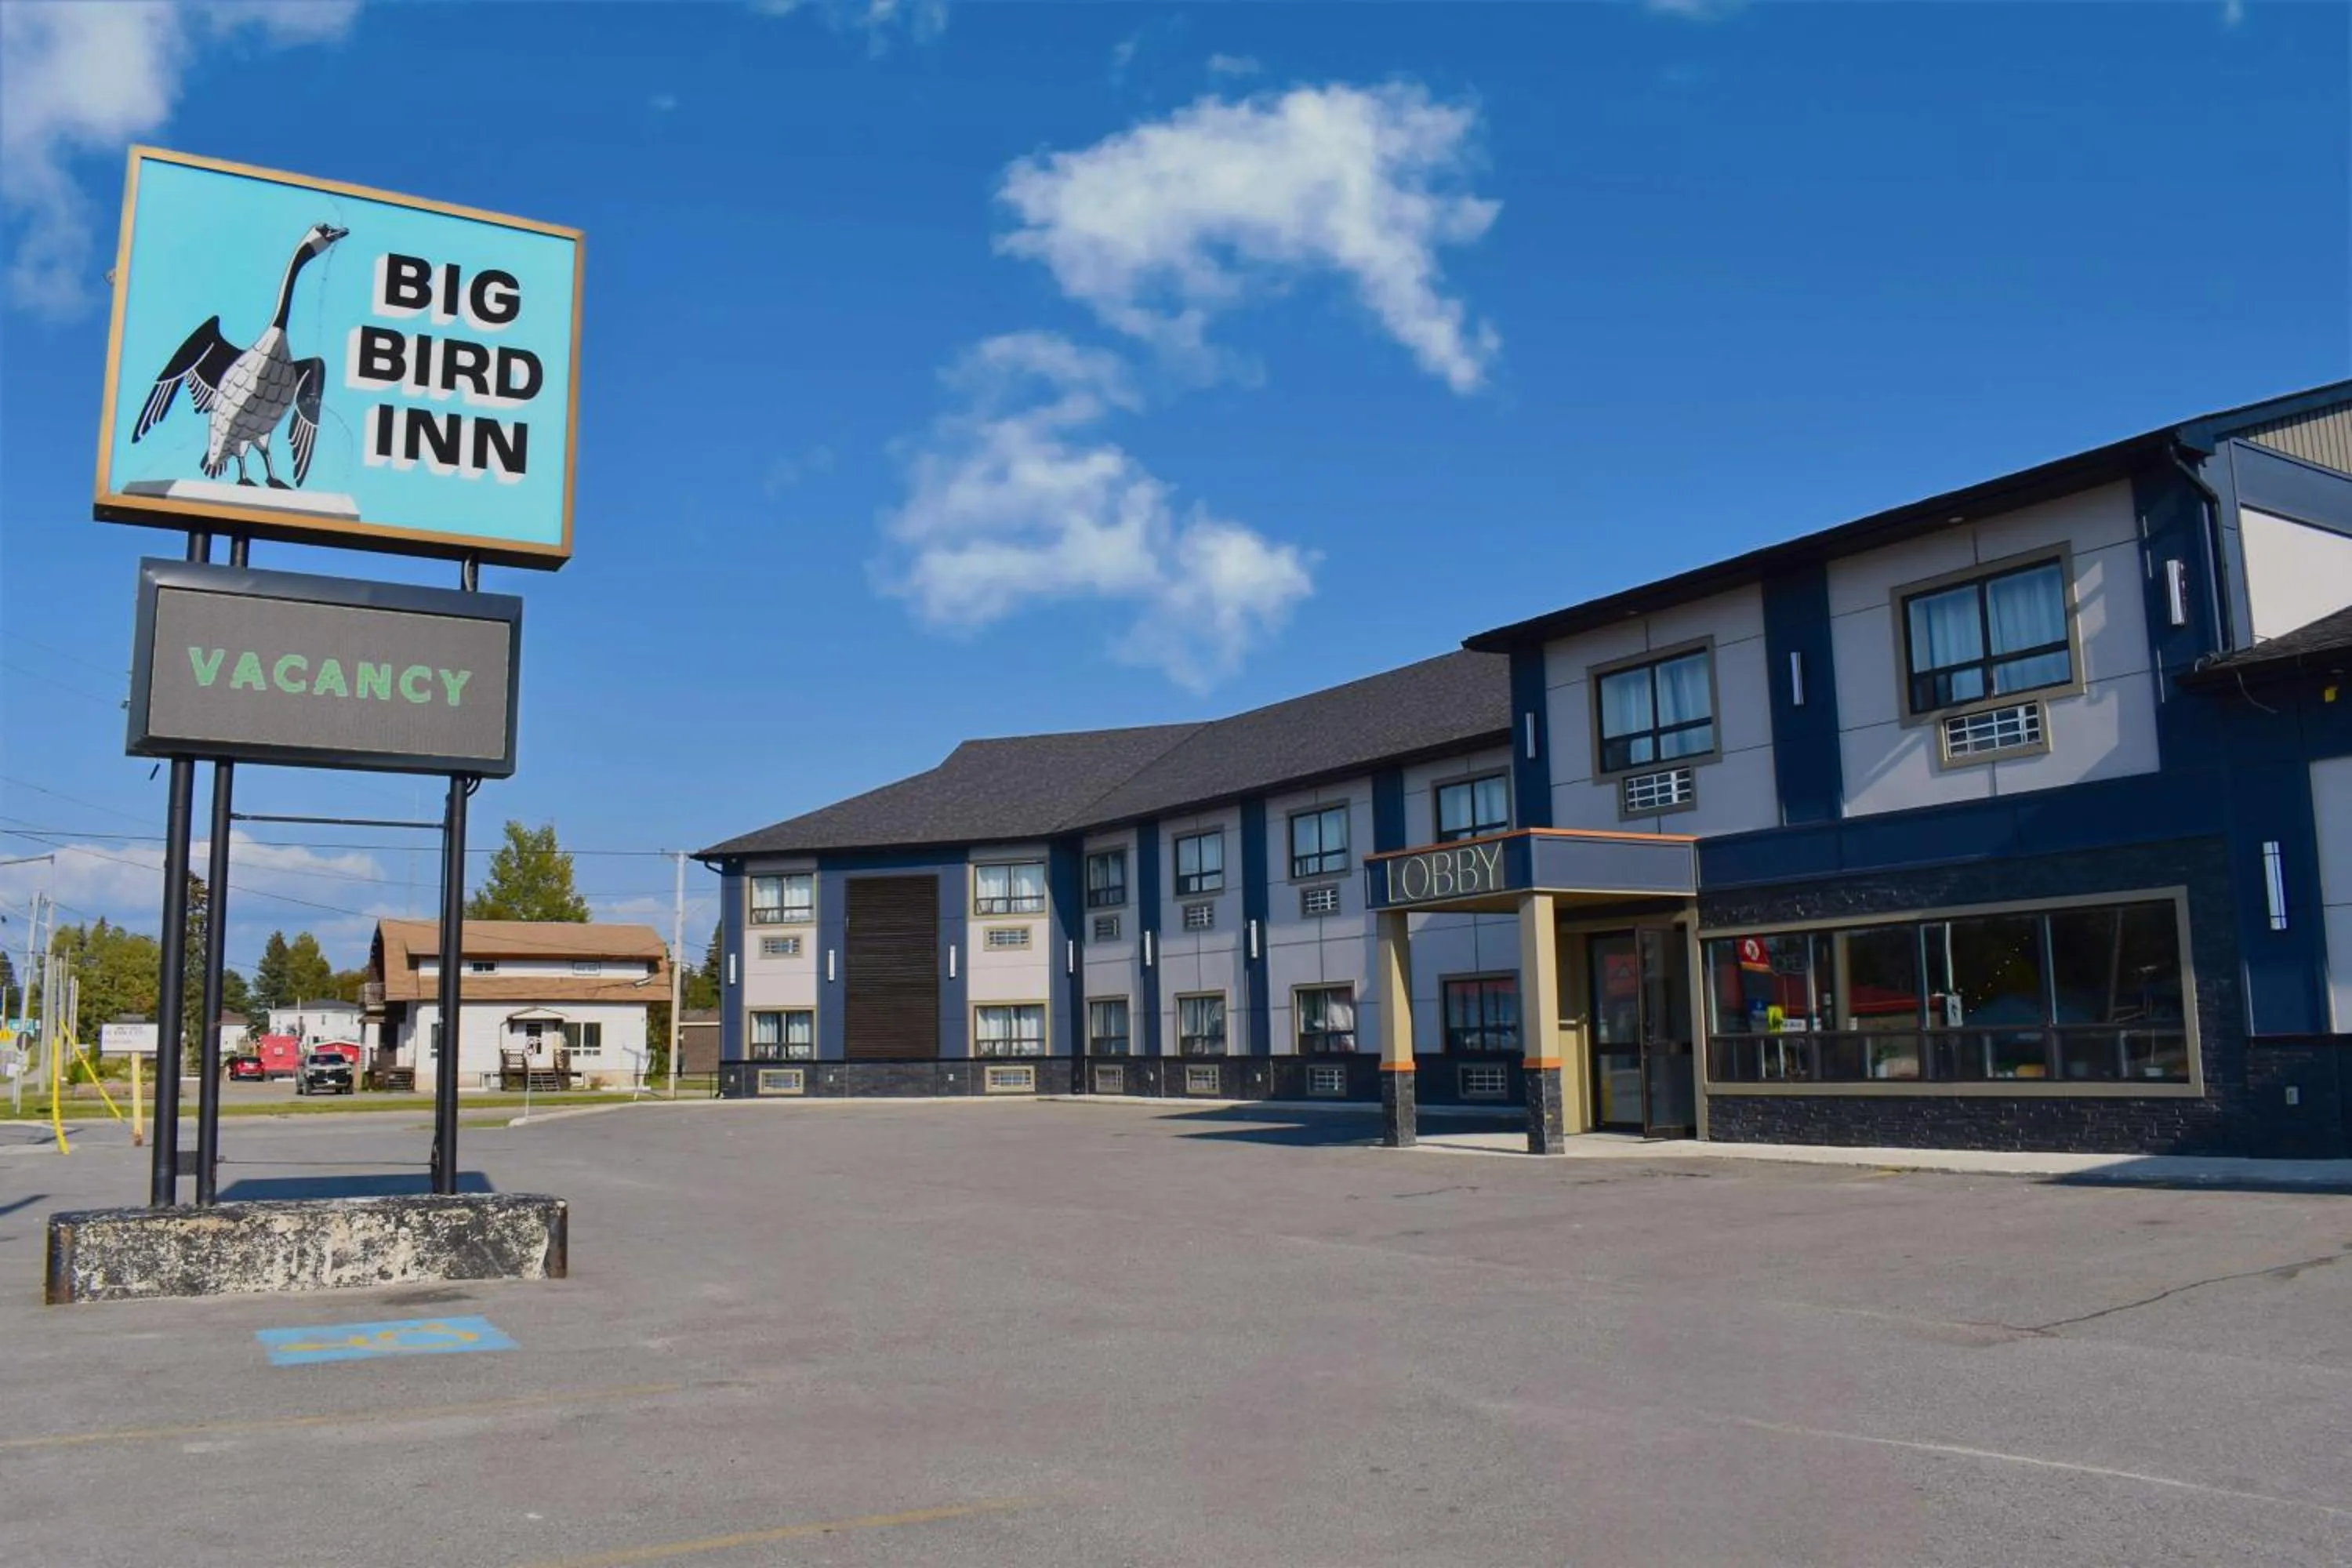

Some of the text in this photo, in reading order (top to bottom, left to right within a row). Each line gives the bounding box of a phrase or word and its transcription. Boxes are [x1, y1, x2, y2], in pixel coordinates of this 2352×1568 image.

[385, 252, 521, 324] BIG
[358, 325, 543, 401] BIRD
[376, 404, 528, 474] INN
[188, 647, 472, 706] VACANCY
[1387, 840, 1502, 902] LOBBY
